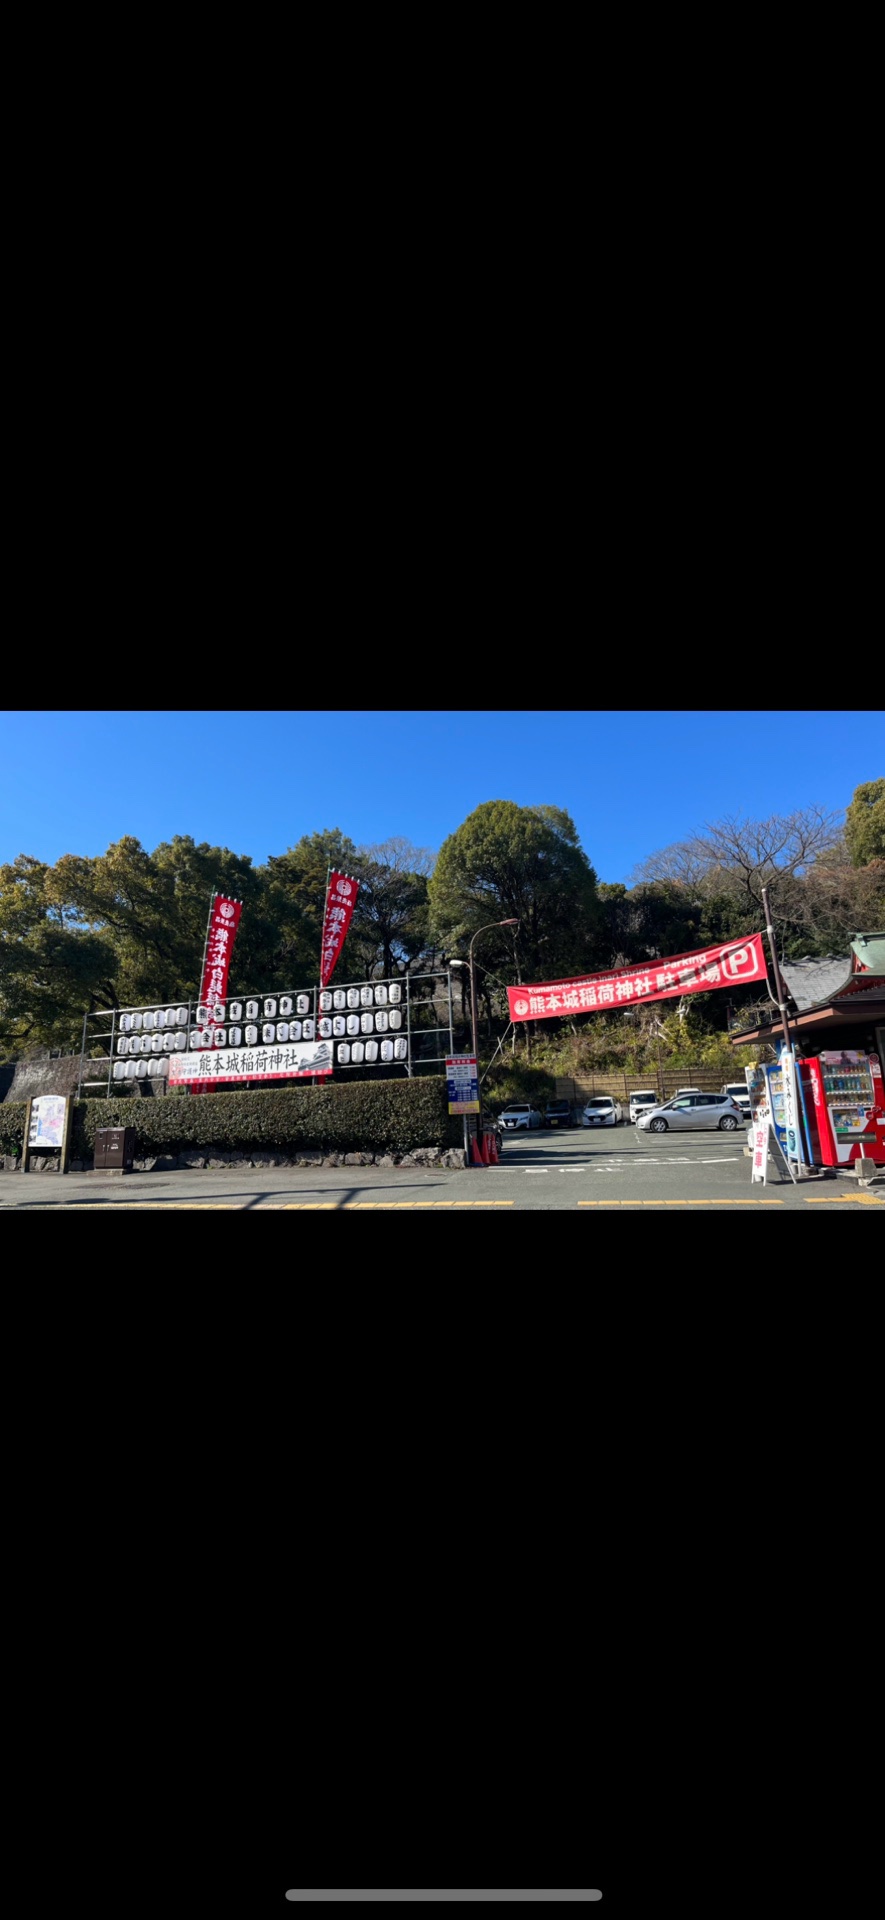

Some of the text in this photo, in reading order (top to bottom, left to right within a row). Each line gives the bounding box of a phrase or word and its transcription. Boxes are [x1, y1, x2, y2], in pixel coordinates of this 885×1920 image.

[663, 954, 707, 970] Parking
[527, 979, 571, 994] Kumamoto
[621, 967, 650, 979] Shrine
[529, 961, 721, 1015] 熊本城稲荷神社 駐車場
[198, 1048, 299, 1077] 熊本城稲荷神社
